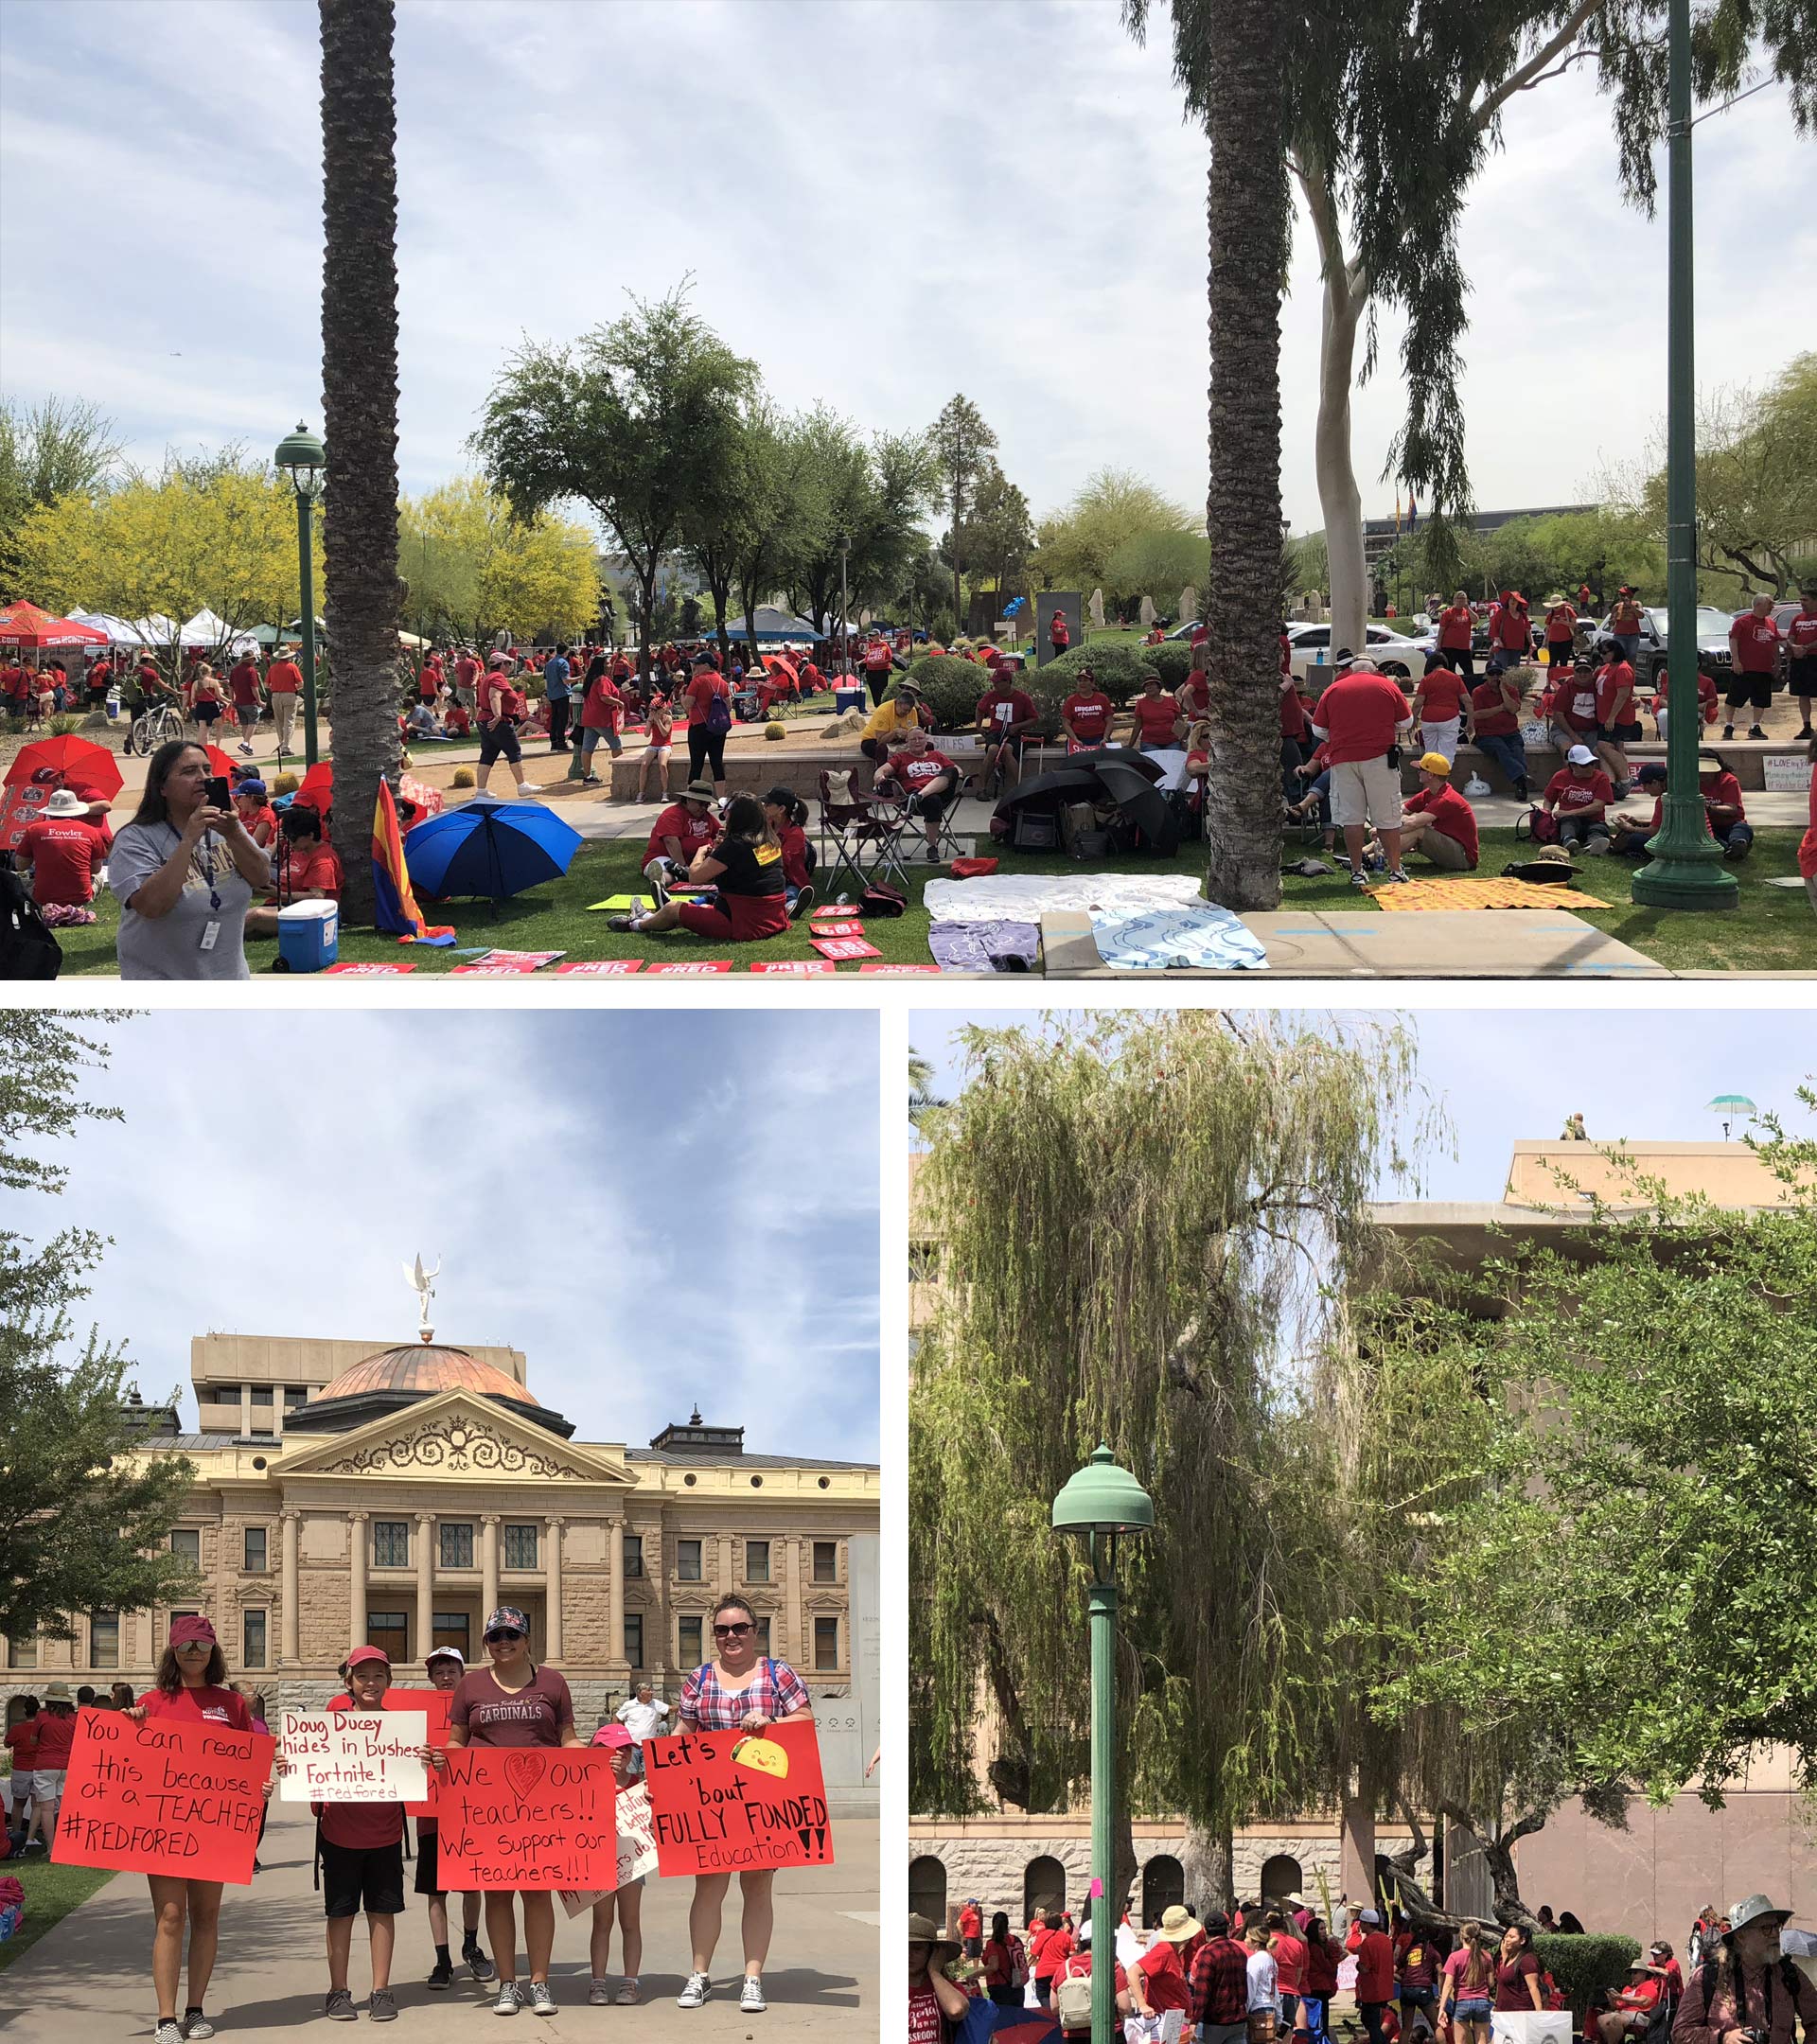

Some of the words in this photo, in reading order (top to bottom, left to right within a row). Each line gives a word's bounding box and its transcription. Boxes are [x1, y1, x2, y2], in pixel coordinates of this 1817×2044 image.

[48, 828, 83, 837] Fowler
[286, 1713, 329, 1742] Doug
[333, 1711, 383, 1740] Ducey
[479, 1706, 542, 1724] CARDINALS
[83, 1714, 119, 1742] You
[136, 1726, 184, 1754] can
[202, 1736, 254, 1761] read
[284, 1736, 331, 1754] hides
[342, 1736, 358, 1756] in
[365, 1736, 421, 1758] bushes
[650, 1736, 716, 1769] Let's
[92, 1748, 143, 1784] this
[163, 1757, 254, 1796] because
[307, 1759, 386, 1785] Fortnite!
[445, 1751, 492, 1787] We
[549, 1761, 601, 1785] our
[80, 1781, 108, 1799] of
[121, 1788, 141, 1806] a
[309, 1785, 397, 1799] #redfored
[688, 1774, 749, 1806] 'bout
[460, 1788, 596, 1825] teachers!!
[656, 1808, 730, 1845] FULLY
[746, 1795, 828, 1835] FUNDED
[62, 1813, 200, 1858] #REDFORED
[440, 1828, 483, 1859] We
[497, 1828, 567, 1861] support
[575, 1832, 607, 1850] our
